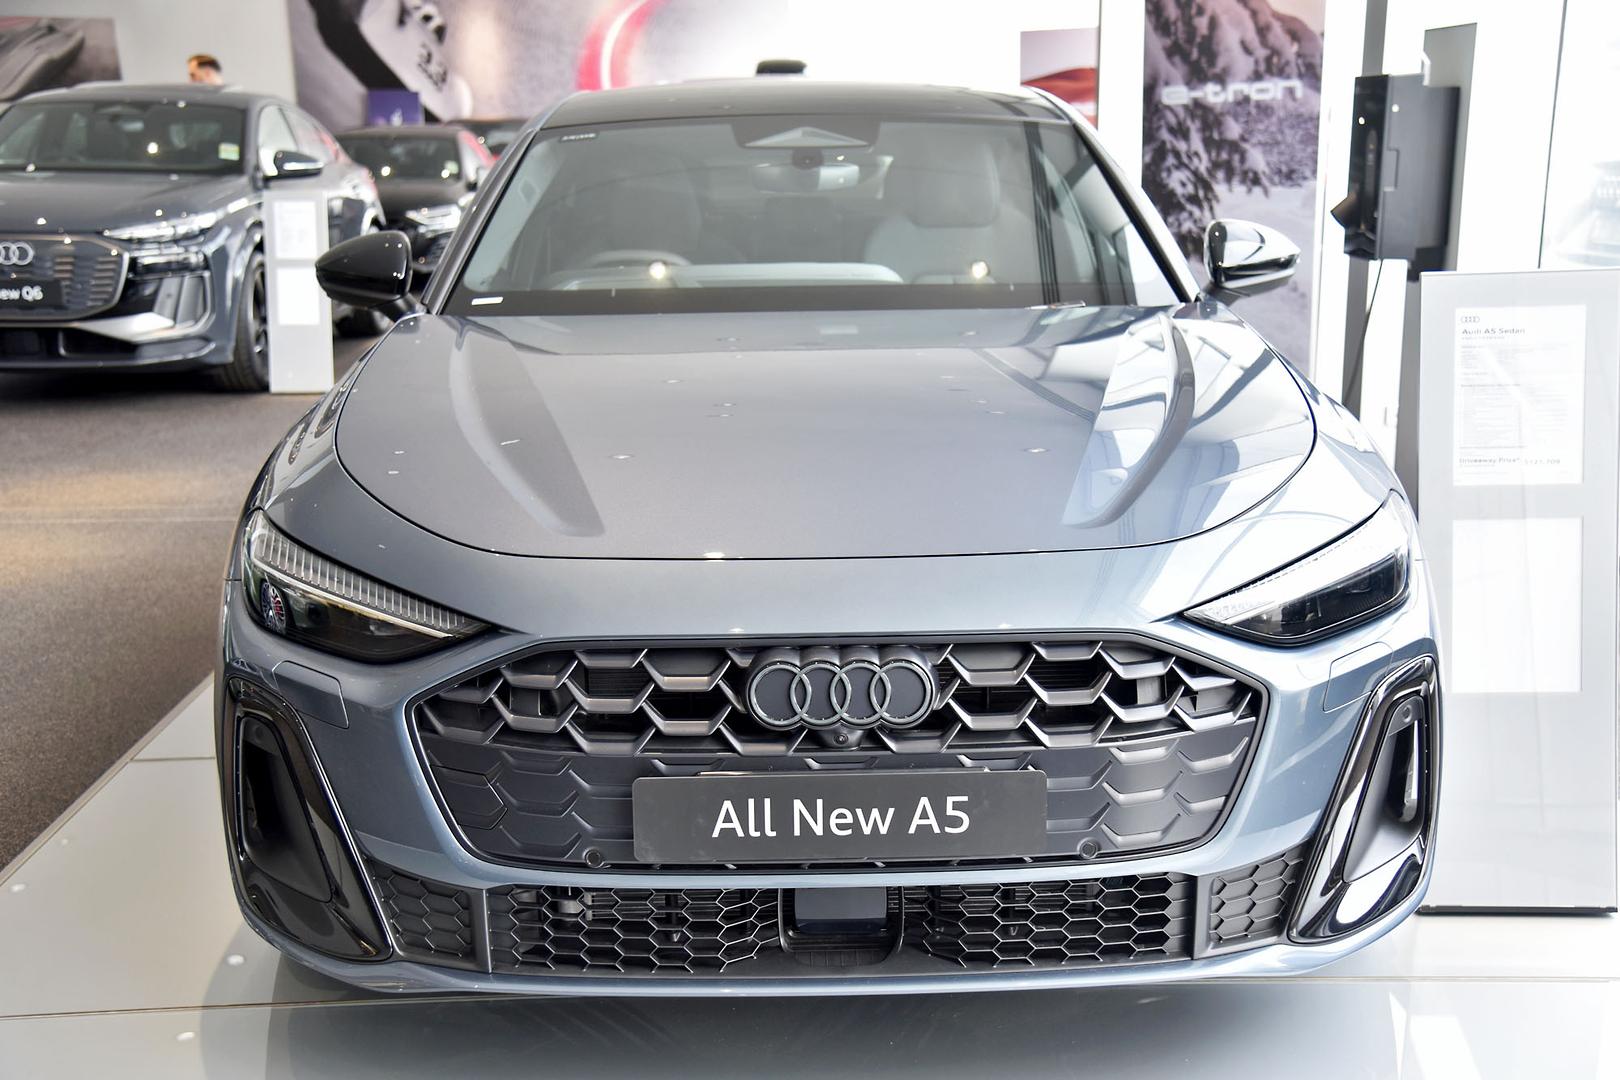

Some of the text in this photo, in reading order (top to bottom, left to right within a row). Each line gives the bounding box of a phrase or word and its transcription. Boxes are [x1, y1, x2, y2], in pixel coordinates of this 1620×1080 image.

[1162, 79, 1302, 106] e-tron
[0, 285, 44, 301] ew Q6
[711, 795, 970, 838] All New A5
